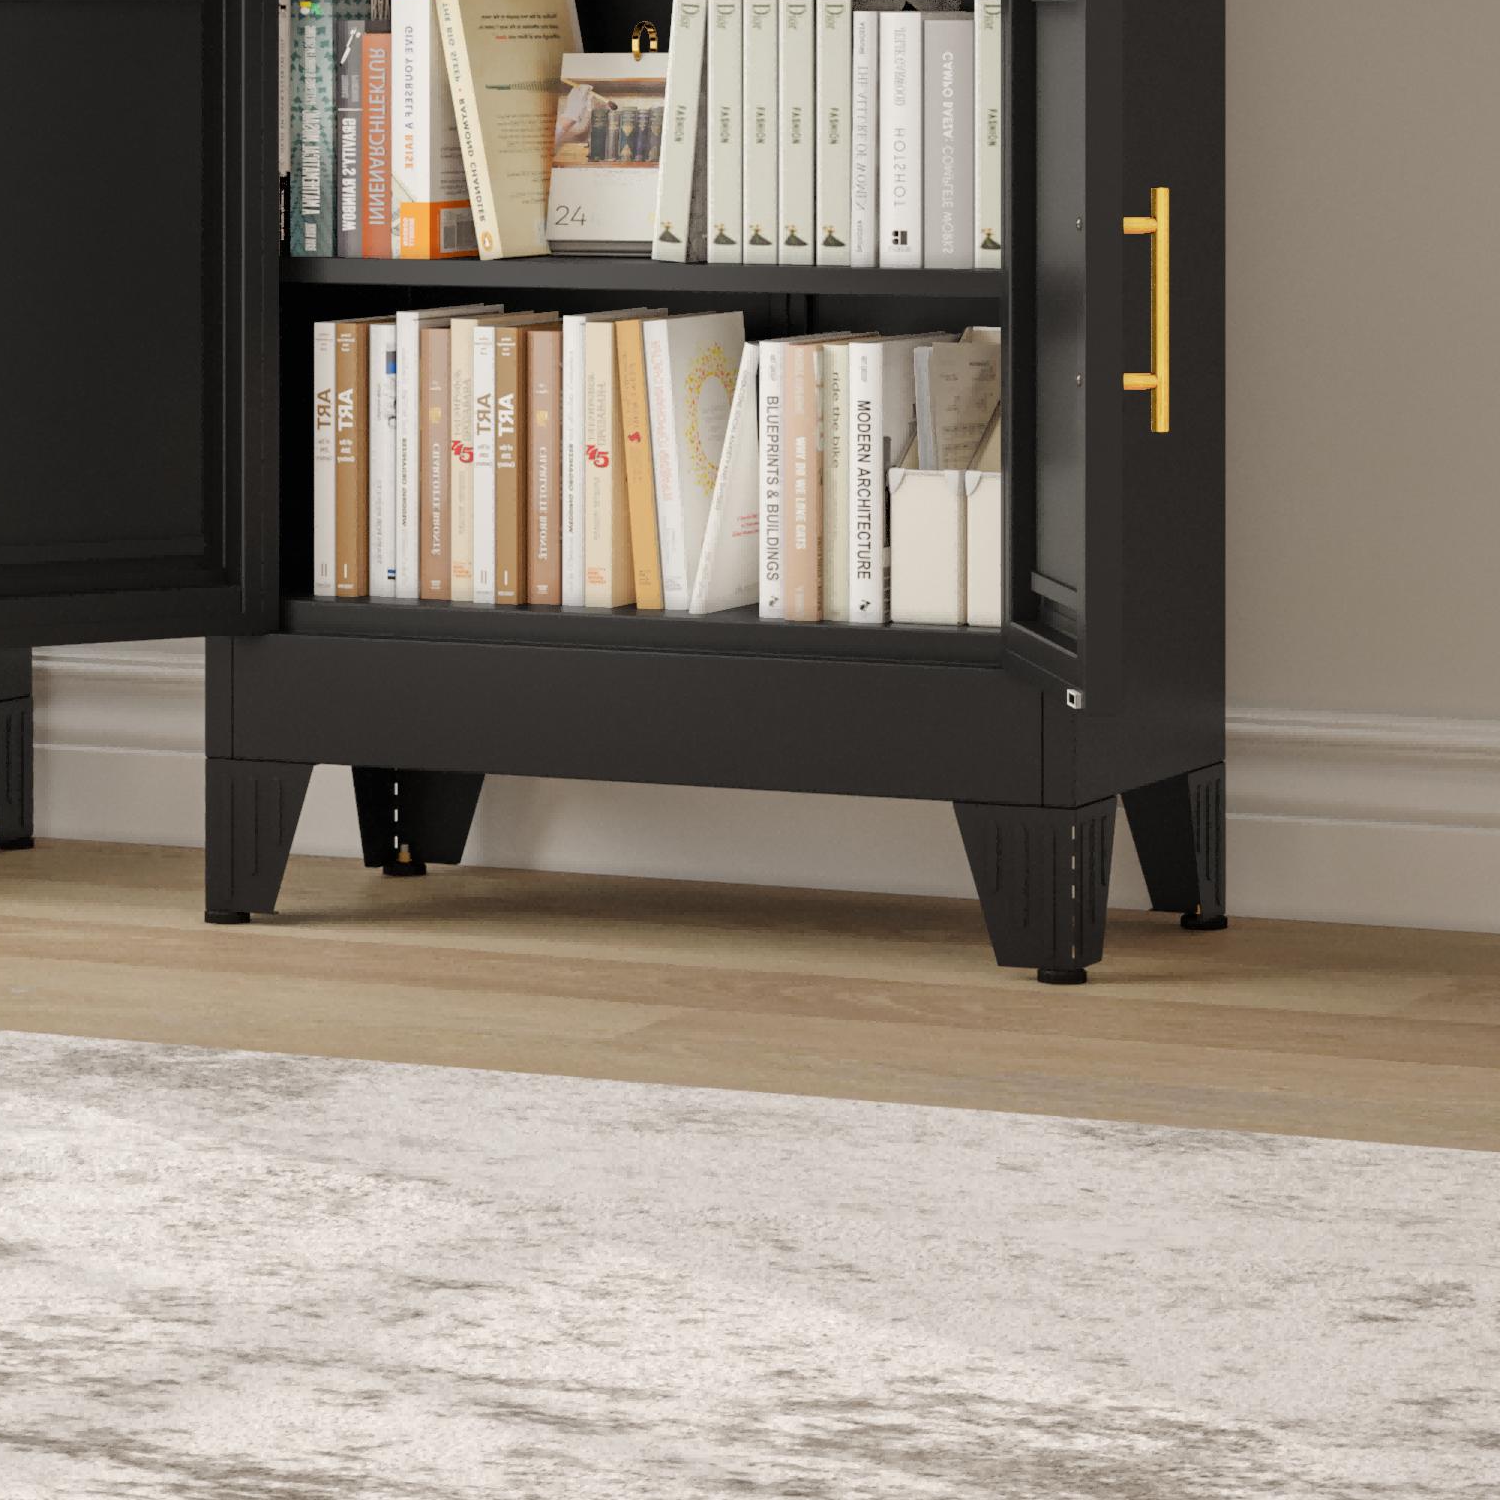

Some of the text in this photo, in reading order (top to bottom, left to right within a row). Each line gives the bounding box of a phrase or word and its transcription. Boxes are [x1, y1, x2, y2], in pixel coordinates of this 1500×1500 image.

[674, 105, 687, 143] FASHION
[719, 106, 730, 145] FASHION
[755, 106, 765, 145] FASHION
[791, 107, 801, 145] FASHION
[829, 107, 839, 145] FASHION
[987, 108, 998, 146] FASHION
[555, 205, 587, 227] 24
[832, 371, 841, 469] ride the bike
[766, 396, 779, 486] BLUEPRINTS
[766, 489, 779, 499] &
[857, 400, 871, 580] MODERN ARCHITECTURE
[766, 503, 779, 581] BUILDINGS
